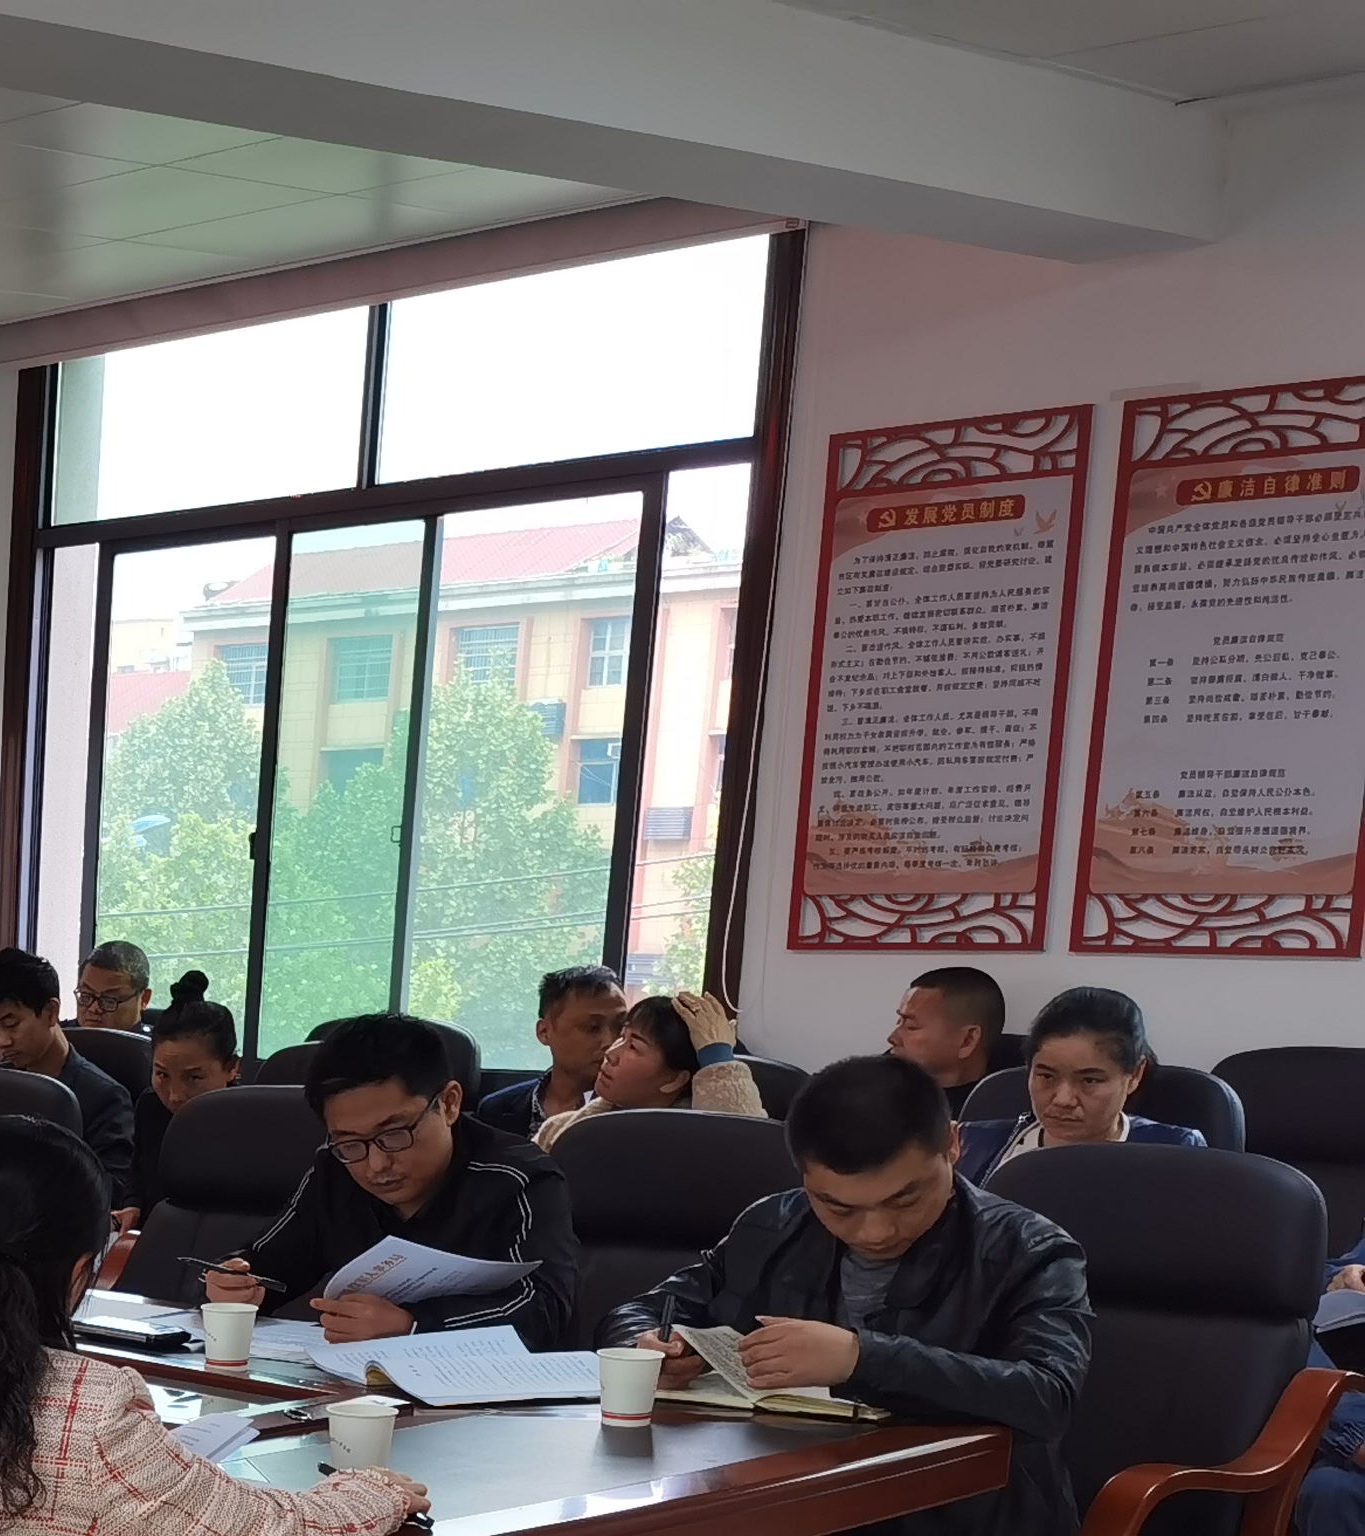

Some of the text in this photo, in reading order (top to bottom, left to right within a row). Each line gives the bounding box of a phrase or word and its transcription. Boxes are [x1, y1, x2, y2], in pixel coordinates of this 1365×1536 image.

[1217, 469, 1348, 499] 廉洁自律准则
[904, 499, 1015, 526] 发展党员制度
